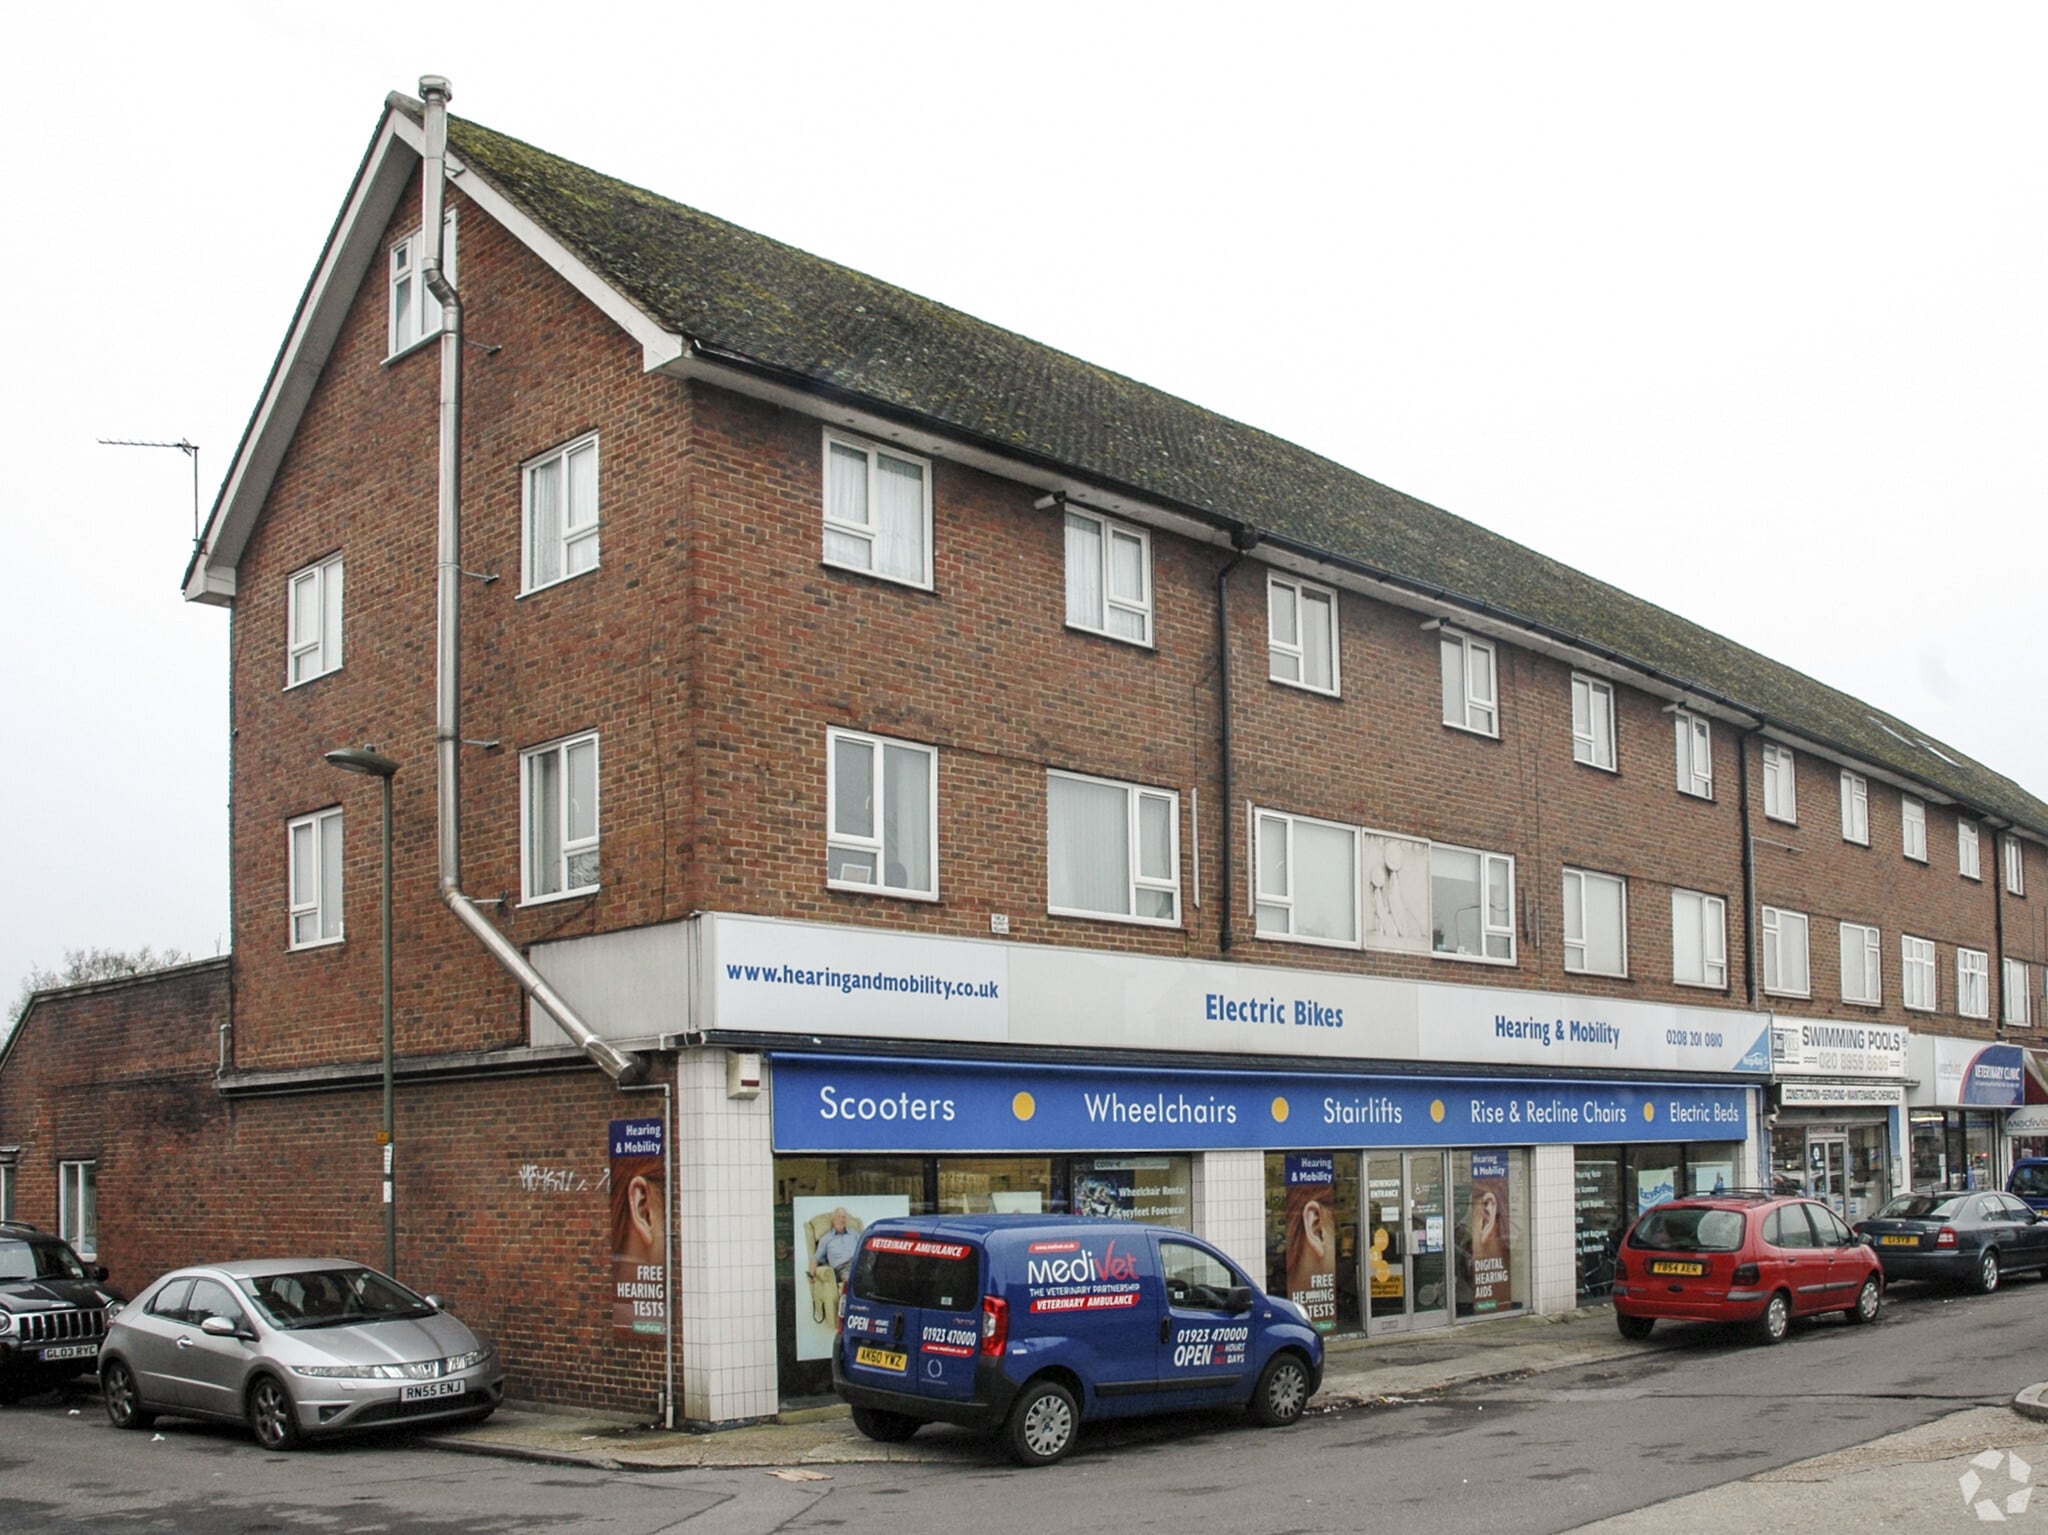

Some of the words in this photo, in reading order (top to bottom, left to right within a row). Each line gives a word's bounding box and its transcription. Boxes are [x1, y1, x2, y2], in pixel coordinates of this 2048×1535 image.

[727, 962, 999, 1000] www.hearingandmobility.co.uk
[1205, 993, 1285, 1026] Electric
[1294, 999, 1344, 1028] Bikes
[1495, 1015, 1551, 1046] Hearing
[1555, 1019, 1566, 1041] &
[1570, 1020, 1620, 1049] Mobility
[1666, 1029, 1687, 1046] 0208
[1690, 1031, 1703, 1047] 201
[1705, 1032, 1723, 1048] 0810
[1802, 1025, 1865, 1050] SWIMMING
[1868, 1031, 1900, 1052] POOLS
[1819, 1052, 1837, 1070] 020
[1975, 1065, 2003, 1079] VETERINARY
[2004, 1067, 2020, 1081] CLINIC
[820, 1086, 956, 1122] Scooters
[1084, 1092, 1237, 1124] Wheelchairs
[1323, 1096, 1402, 1125] Stairlifts
[1471, 1100, 1505, 1123] Rise
[1509, 1101, 1521, 1123] &
[1526, 1100, 1579, 1124] Recline
[1583, 1100, 1628, 1124] Chairs
[1670, 1101, 1711, 1123] Electric
[1714, 1101, 1740, 1124] Beds
[625, 1124, 662, 1138] Hearing
[615, 1142, 623, 1153] &
[624, 1141, 662, 1155] Mobility
[1301, 1156, 1333, 1170] Hearing
[1472, 1153, 1498, 1167] Hearing
[1291, 1171, 1299, 1183] &
[1300, 1170, 1333, 1184] Mobility
[1472, 1166, 1479, 1178] &
[1480, 1165, 1506, 1178] Mobility
[1118, 1186, 1160, 1197] Wheelchair
[1162, 1185, 1187, 1196] Rental
[1151, 1205, 1186, 1217] Footwear
[871, 1238, 914, 1251] VETERINARY
[914, 1241, 964, 1257] AMBULANCE
[637, 1265, 664, 1281] FREE
[1474, 1257, 1504, 1273] DIGITAL
[1311, 1273, 1335, 1288] FREE
[1475, 1270, 1508, 1285] HEARING
[617, 1282, 664, 1299] HEARING
[1029, 1287, 1044, 1297] THE
[1045, 1285, 1091, 1297] VETERINARY
[1092, 1283, 1140, 1294] PARTNERSHIP
[1475, 1284, 1493, 1299] AIDS
[632, 1300, 664, 1317] TESTS
[1036, 1298, 1086, 1311] VETERINARY
[1087, 1294, 1133, 1308] AMBULANCE
[1307, 1303, 1336, 1318] TESTS
[847, 1315, 869, 1331] OPEN
[922, 1326, 946, 1342] 01923
[946, 1330, 977, 1346] 470000
[1177, 1328, 1211, 1344] 01923
[1211, 1326, 1249, 1342] 470000
[46, 1348, 74, 1358] GL03
[76, 1345, 95, 1356] RYC
[1174, 1343, 1213, 1367] OPEN
[1225, 1342, 1246, 1353] HOURS
[861, 1349, 882, 1363] AK60
[884, 1352, 902, 1368] YWZ
[1227, 1353, 1245, 1364] DAYS
[406, 1385, 437, 1399] RN55
[439, 1381, 461, 1395] ENJ
